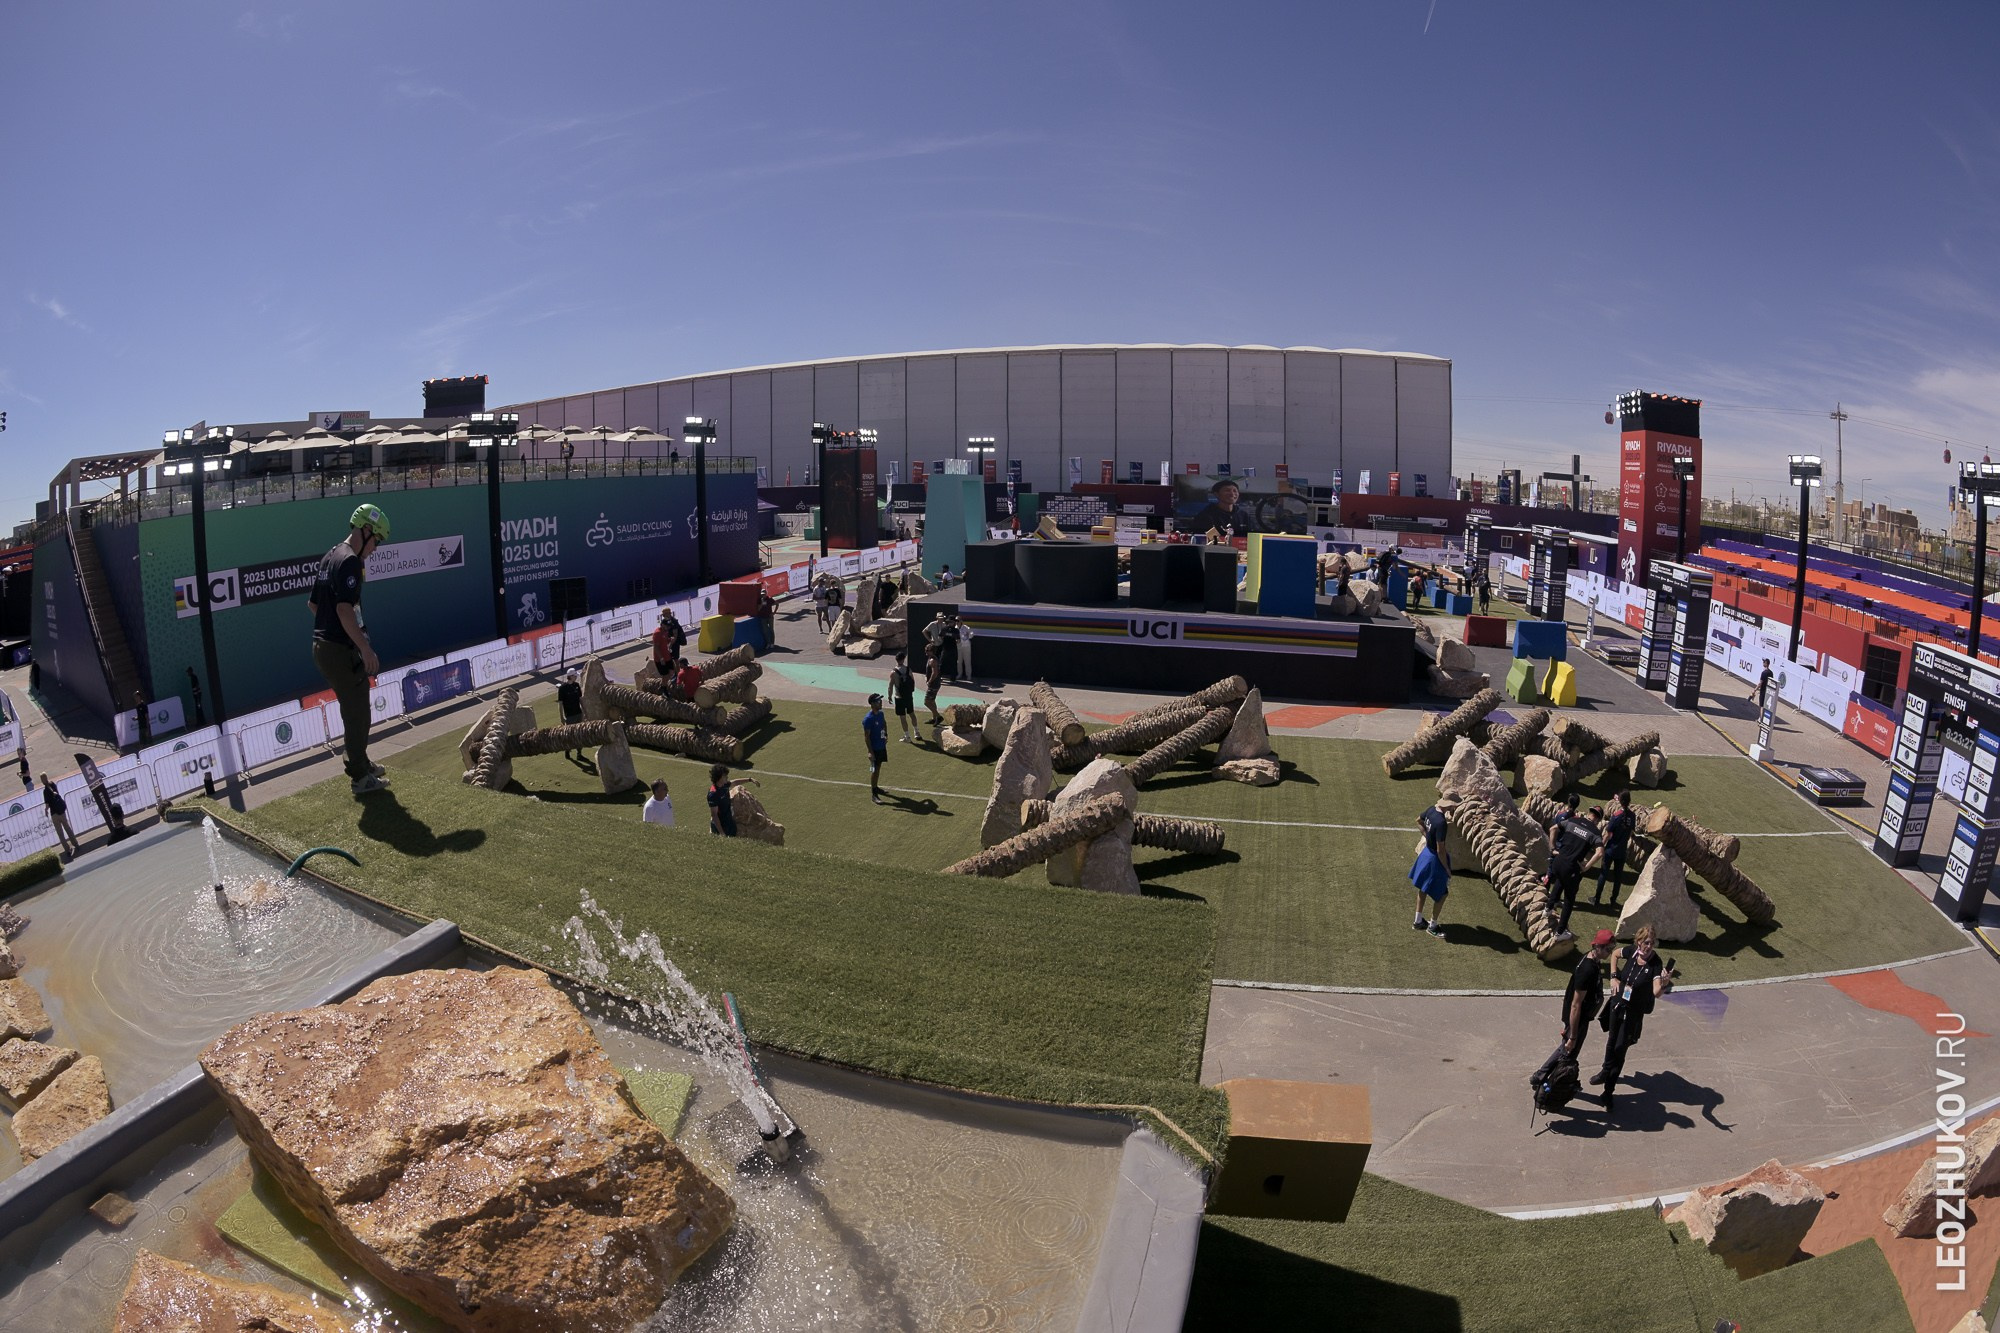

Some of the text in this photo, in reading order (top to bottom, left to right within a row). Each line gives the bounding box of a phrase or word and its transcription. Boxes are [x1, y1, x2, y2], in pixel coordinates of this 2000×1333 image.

[1625, 441, 1641, 451] RIYADH
[1656, 441, 1692, 456] RIYADH
[711, 509, 748, 522] وزارة الرياضة
[501, 516, 558, 541] RIYADH
[616, 520, 672, 534] SAUDI CYCLING
[369, 550, 399, 563] RIYADH
[502, 541, 559, 563] 025 UCI
[369, 558, 426, 576] SAUDI ARABIA
[540, 560, 559, 568] WORLD
[243, 561, 320, 584] 2025 URBAN CYC
[504, 569, 560, 585] HAMPIONSHIPS
[186, 575, 236, 608] UCI
[244, 582, 281, 598] WORLD
[282, 575, 317, 592] CHAMP
[1131, 619, 1177, 640] UCI
[1741, 660, 1753, 673] UCI
[1919, 651, 1933, 666] UCI
[1766, 695, 1772, 710] 4
[1911, 697, 1924, 714] UCI
[1944, 692, 1967, 711] FINISH
[1945, 728, 1975, 751] 8:23:27
[1979, 733, 2000, 749] SHIMANO
[84, 763, 96, 781] 5
[187, 754, 214, 775] UCI
[1803, 778, 1814, 790] UCI
[1892, 779, 1909, 795] SHIMANO
[1973, 774, 1988, 788] TISSOT
[1835, 788, 1849, 797] UCI
[1888, 811, 1900, 828] UCI
[1967, 811, 1978, 820] UCI
[1573, 826, 1588, 838] SUISSE
[1909, 822, 1923, 832] UCI
[1958, 823, 1977, 842] SHIMANO
[1951, 862, 1966, 879] UCI
